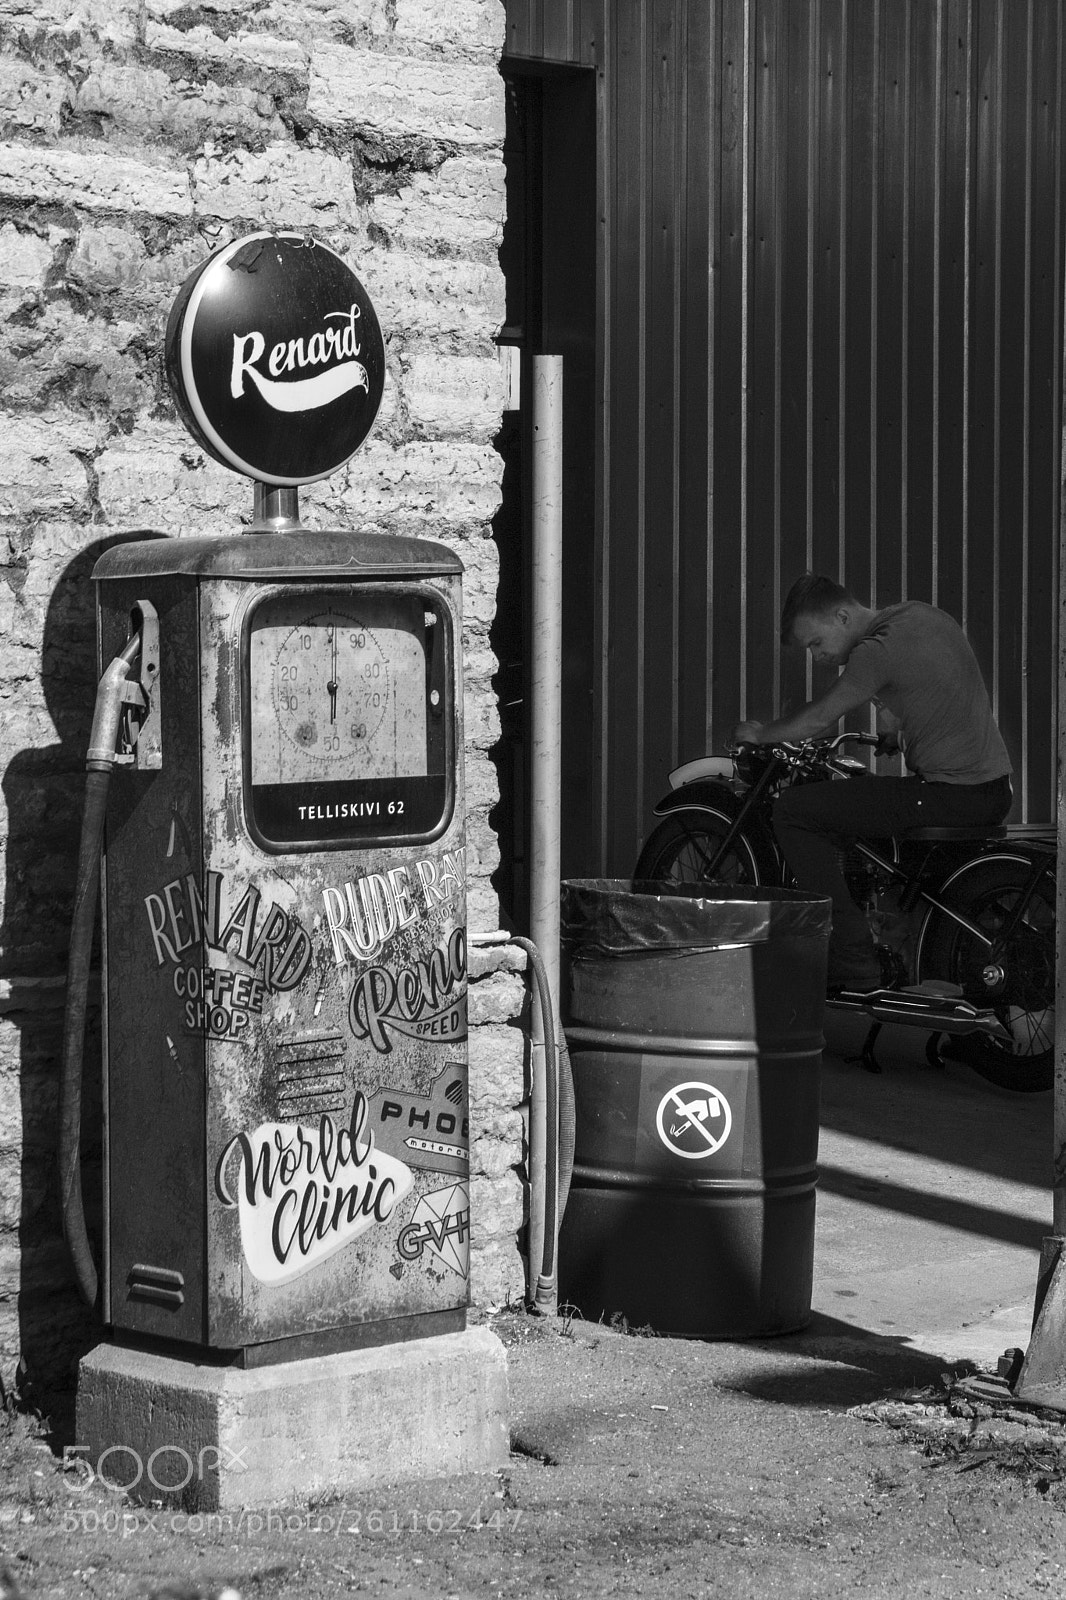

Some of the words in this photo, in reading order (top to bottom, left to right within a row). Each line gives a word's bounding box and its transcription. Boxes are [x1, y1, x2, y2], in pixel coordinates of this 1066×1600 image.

[231, 303, 369, 412] Renard
[299, 634, 311, 650] 10
[350, 633, 366, 648] 90
[281, 666, 297, 681] 20
[364, 663, 380, 678] 80
[363, 692, 380, 708] 70
[350, 723, 367, 739] 60
[323, 736, 340, 752] 50
[298, 801, 381, 820] TELLISKIVI
[387, 801, 405, 814] 62
[321, 866, 419, 966] RUDE
[392, 902, 456, 952] BARBERSHOP
[144, 870, 312, 995] RENARD
[173, 967, 264, 1014] COFFEE
[185, 1000, 250, 1037] SHOP
[416, 1011, 459, 1035] SPEED
[215, 1091, 375, 1206] World
[272, 1165, 395, 1264] Clinic
